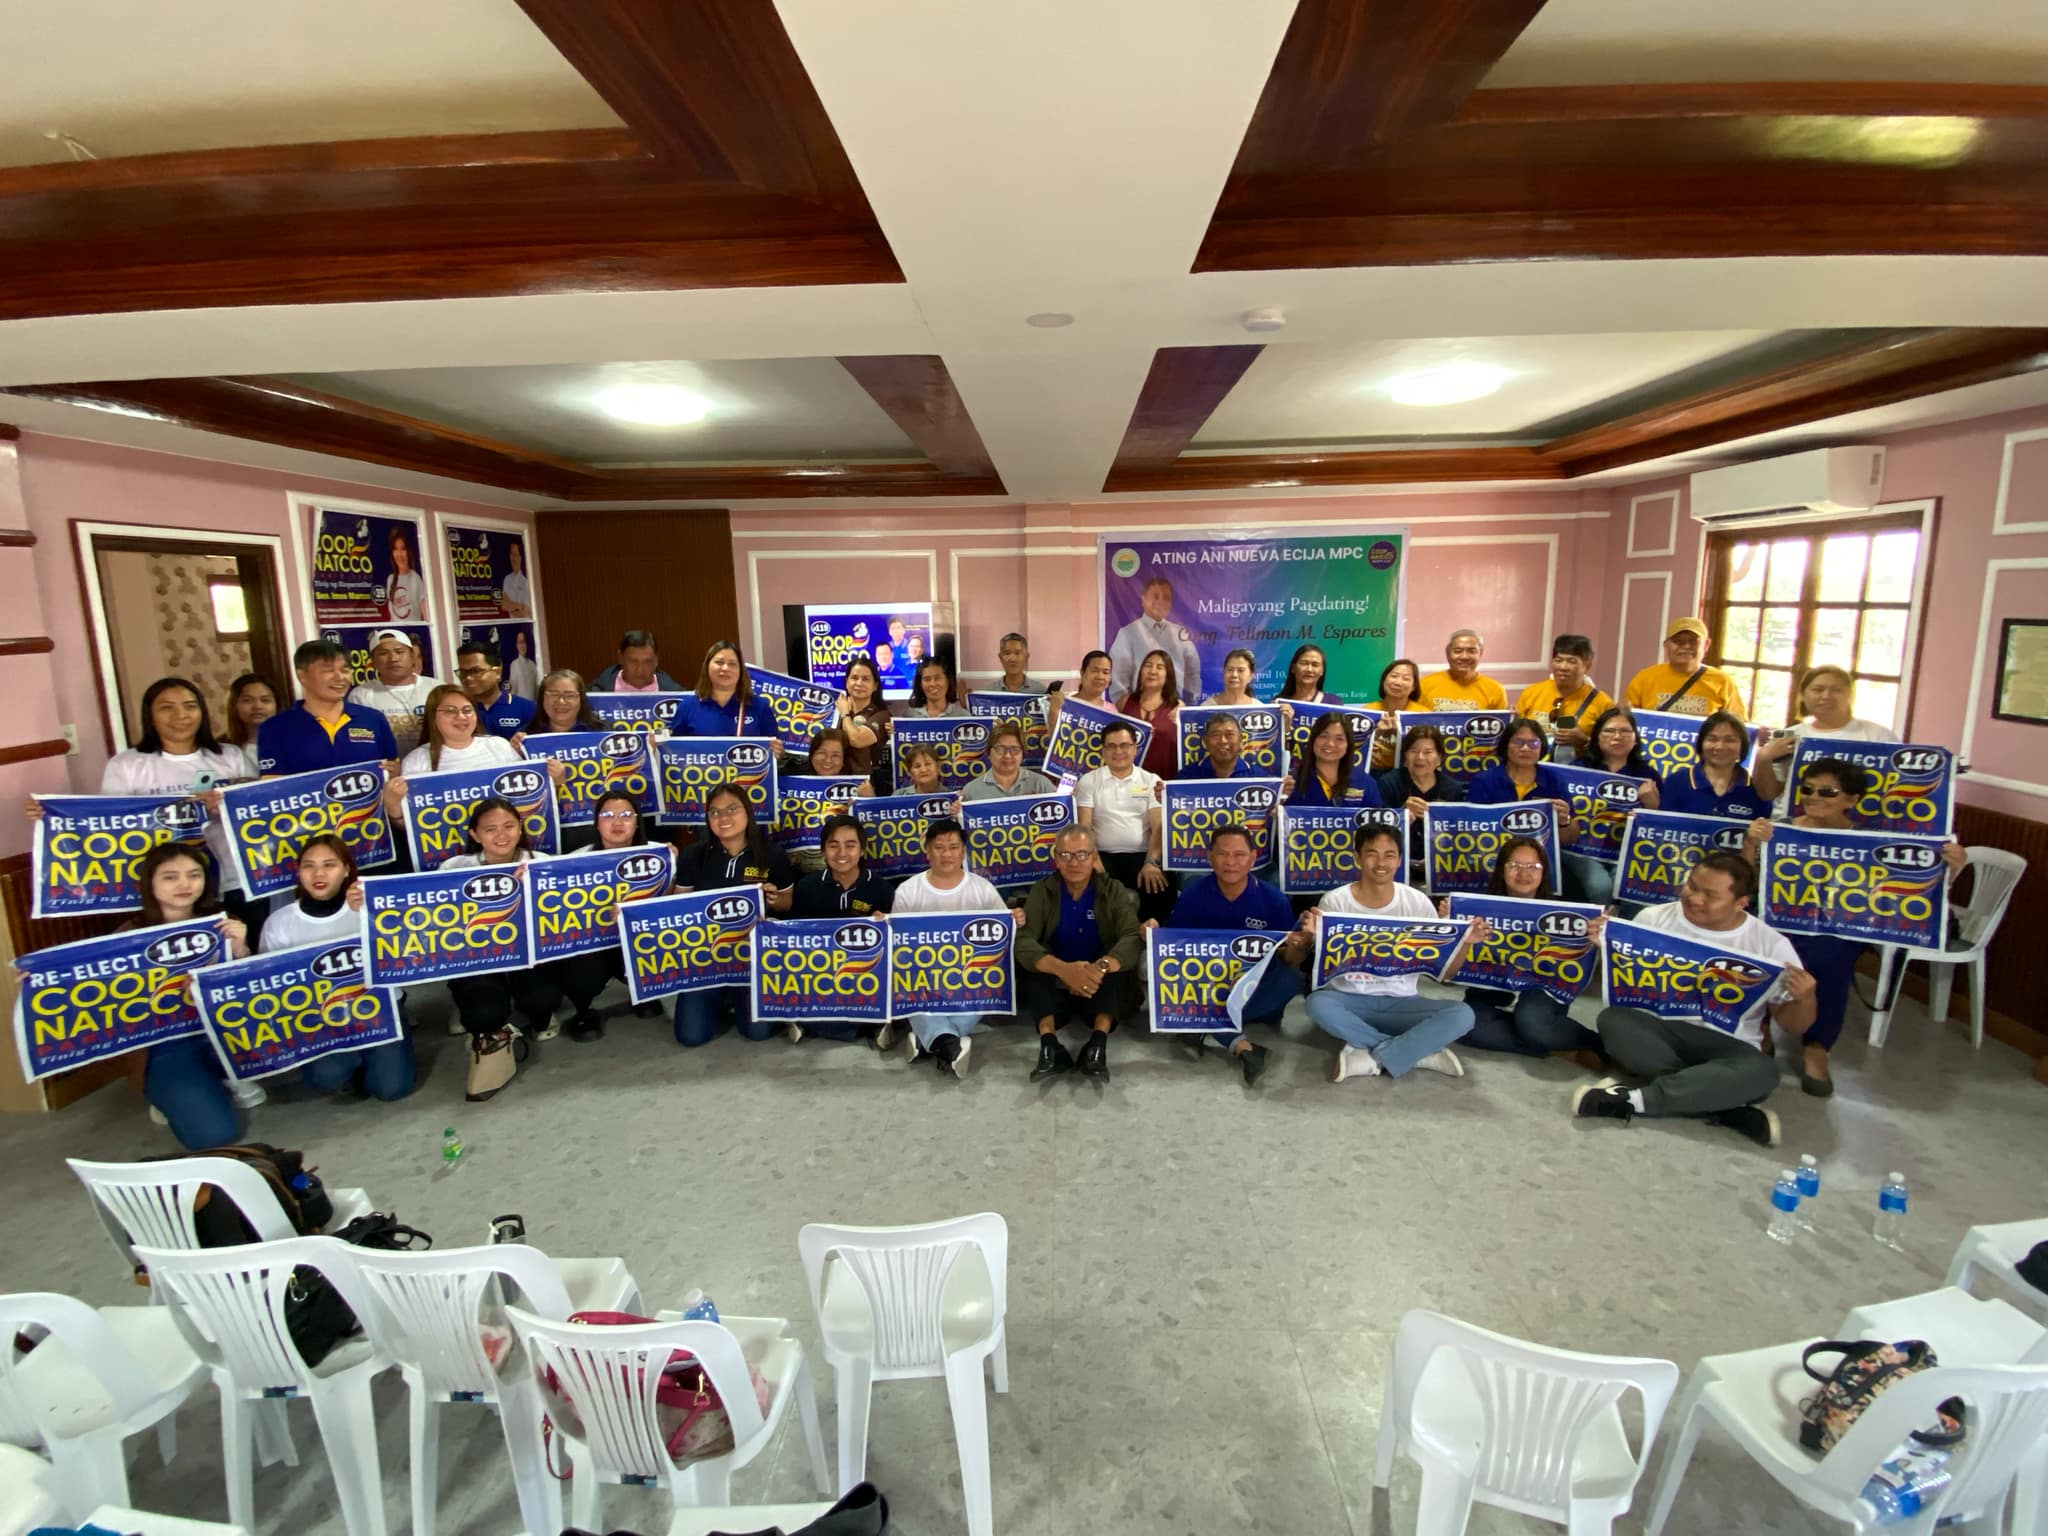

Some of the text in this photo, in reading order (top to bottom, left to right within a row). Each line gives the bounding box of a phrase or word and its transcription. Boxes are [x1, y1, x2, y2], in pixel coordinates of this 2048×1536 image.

[320, 534, 354, 554] OOP
[1152, 552, 1197, 565] ATING
[1201, 551, 1225, 564] ANI
[1229, 549, 1279, 563] NUEVA
[1283, 548, 1326, 561] ECIJA
[1329, 547, 1363, 560] MPC
[1198, 595, 1370, 618] Maligayang Pagdating!
[812, 635, 853, 651] COOP
[1228, 624, 1291, 641] Felimon
[1323, 624, 1386, 643] Espares
[751, 680, 831, 706] E-ELECT 119
[972, 705, 1021, 716] RE-ELECT
[1061, 711, 1107, 733] RE-ELEC
[1244, 714, 1274, 730] 119
[898, 726, 985, 742] RE-ELECT 119
[1352, 718, 1371, 732] 19
[1470, 720, 1501, 734] 119
[606, 736, 639, 755] 119
[1060, 723, 1104, 751] COO
[662, 748, 765, 765] RE-ELECT 119
[1054, 739, 1104, 769] NATC
[1898, 751, 1940, 770] 119
[564, 758, 615, 782] OOP
[665, 765, 738, 785] COOP
[151, 783, 190, 795] RE-ELEC
[235, 774, 374, 821] RE-ELECT 119
[414, 773, 539, 808] RE-ELECT 119
[665, 785, 767, 804] NATO
[781, 790, 823, 800] -ELECT
[1171, 790, 1274, 809] RE-ELECT 119
[1603, 784, 1638, 802] 119
[782, 798, 833, 813] OOP
[858, 808, 915, 823] RE-ELECT
[969, 805, 1065, 829] RE-ELECT 119
[50, 814, 151, 831] RE-ELECT
[240, 802, 344, 844] COOP
[1171, 809, 1246, 830] COOP
[1288, 811, 1395, 829] RE-ELECT 119
[1434, 813, 1543, 832] RE-ELECT 119
[50, 829, 173, 860] COOP
[864, 836, 929, 860] NATC
[969, 825, 1040, 849] COOP
[1288, 830, 1356, 851] COO
[1636, 827, 1744, 849] RE-ELECT 11
[1288, 851, 1362, 872] NATC
[1434, 853, 1498, 873] NATC
[1633, 840, 1719, 867] COO
[1775, 842, 1936, 867] RE-ELECT 119
[537, 857, 661, 891] RE-ELECT 119
[1773, 857, 1889, 888] COOP
[373, 877, 513, 910] RE-ELECT 119
[537, 882, 630, 913] COOP
[1772, 882, 1932, 920] NATCCO
[375, 902, 478, 935] COOP
[538, 905, 618, 937] NATC
[631, 900, 750, 933] RE-ELECT 119
[1545, 916, 1587, 937] 119
[376, 922, 518, 960] NATCCO
[633, 923, 721, 954] COOP
[762, 928, 878, 949] RE-ELECT 119
[893, 923, 1004, 945] RE-ELECT 119
[1327, 923, 1400, 937] RE-ELECT
[1483, 929, 1550, 953] OOP
[1159, 943, 1228, 957] RE-ELECT
[1326, 931, 1412, 953] COOP
[30, 933, 211, 988] RE-ELECT 119
[762, 949, 847, 973] COOP
[892, 945, 974, 969] COOP
[1324, 943, 1440, 970] NATCCO
[210, 949, 365, 1004] RE-ELECT 119
[893, 966, 1006, 992] NATCCO
[1159, 957, 1242, 982] COOP
[32, 967, 168, 1016] COOP
[762, 972, 880, 995] NATCCO
[1160, 982, 1230, 1006] NATC
[215, 979, 332, 1028] COOP
[222, 994, 381, 1055] NATCCO
